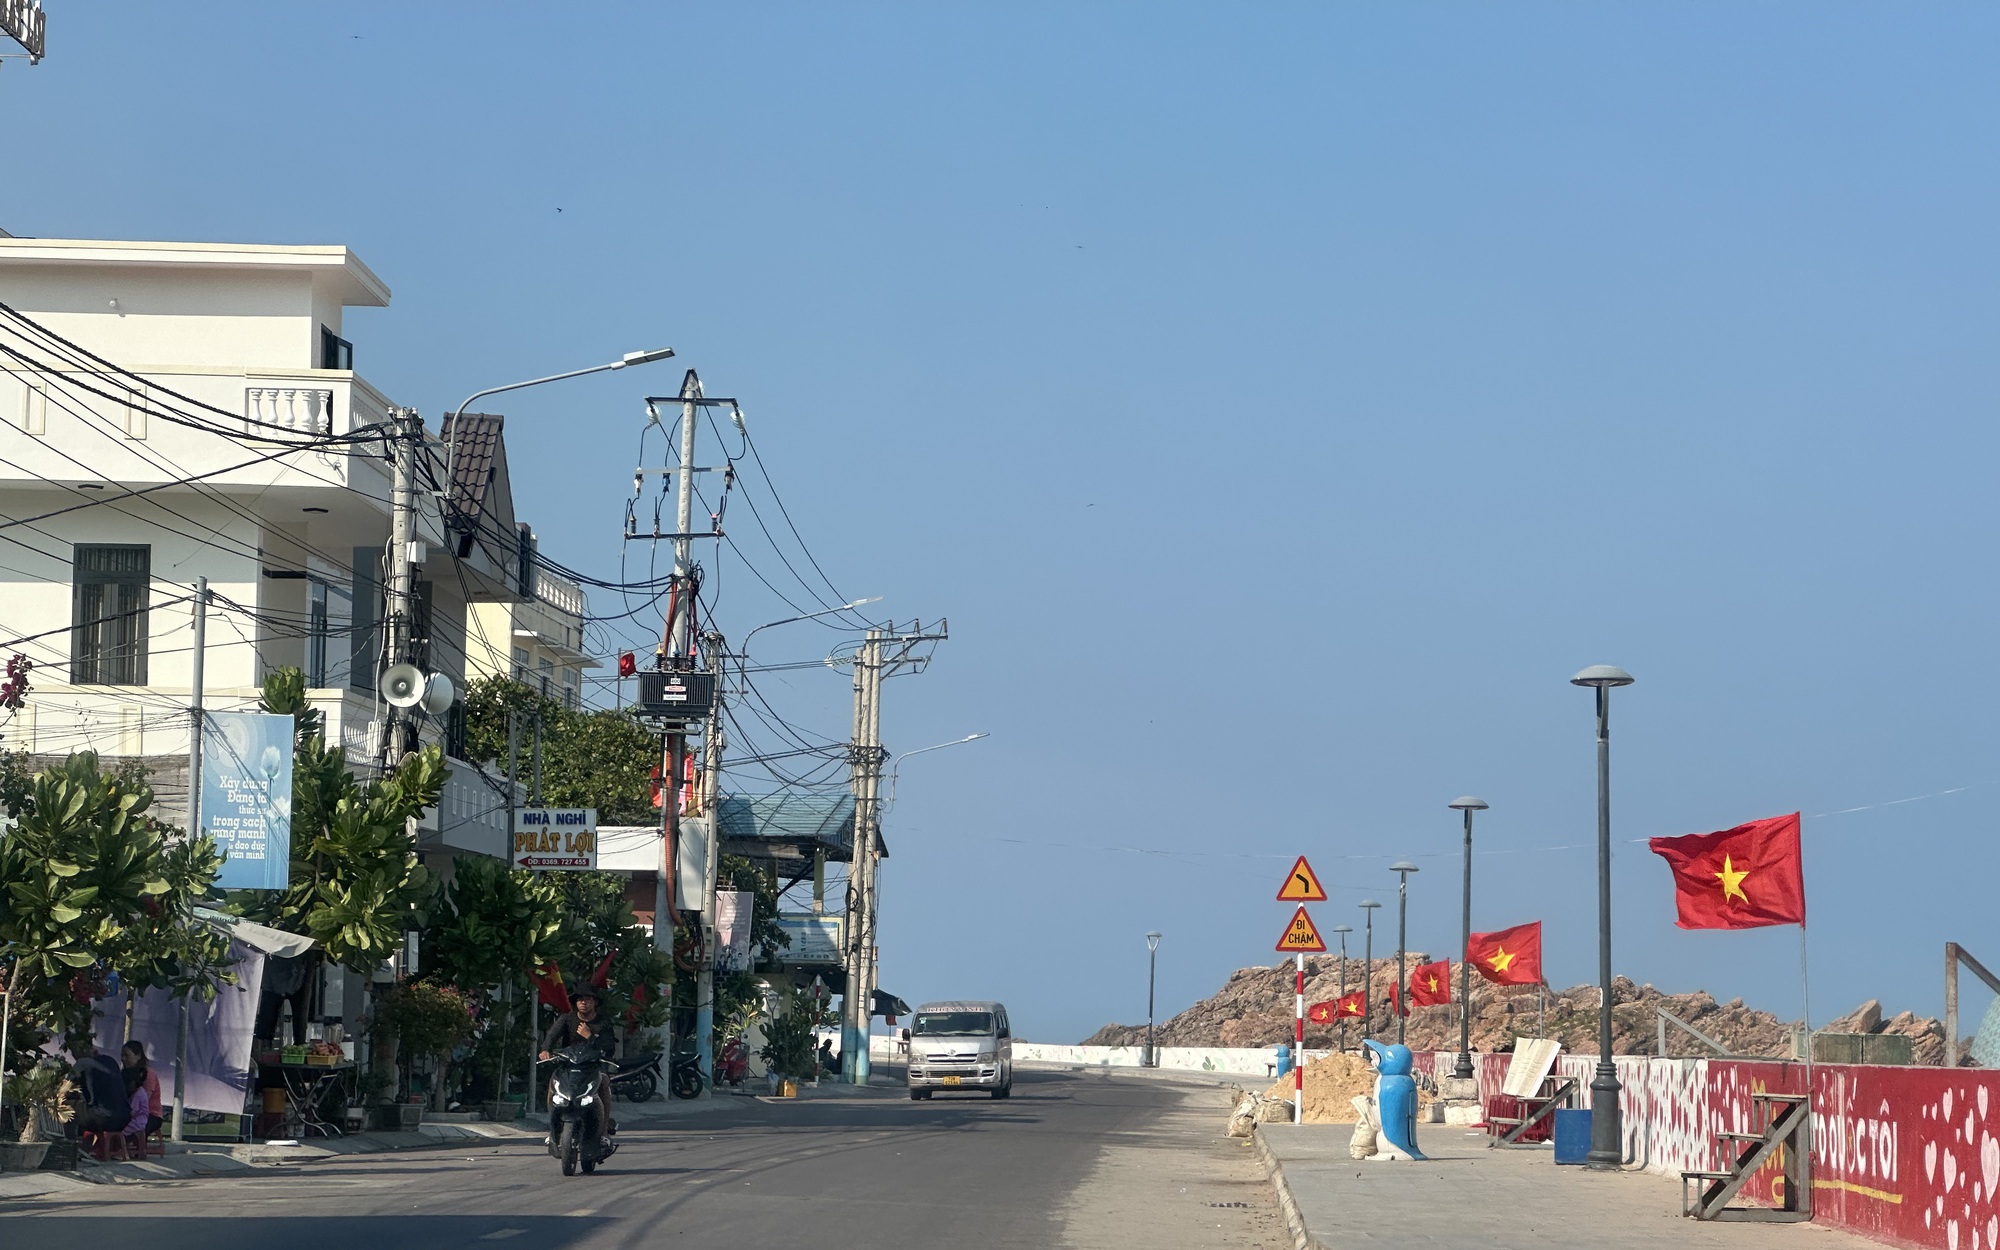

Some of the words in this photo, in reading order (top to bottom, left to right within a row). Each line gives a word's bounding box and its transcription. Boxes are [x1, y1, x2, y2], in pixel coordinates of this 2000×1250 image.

[220, 776, 239, 791] Xây
[258, 794, 267, 803] ta
[213, 815, 240, 829] trong
[523, 811, 551, 825] NHÀ
[556, 809, 587, 825] NGHỈ
[514, 826, 560, 852] PHÁT
[564, 828, 594, 856] LỢI
[246, 850, 265, 859] minh
[1296, 919, 1306, 930] ĐI
[1288, 931, 1315, 947] CHẬM
